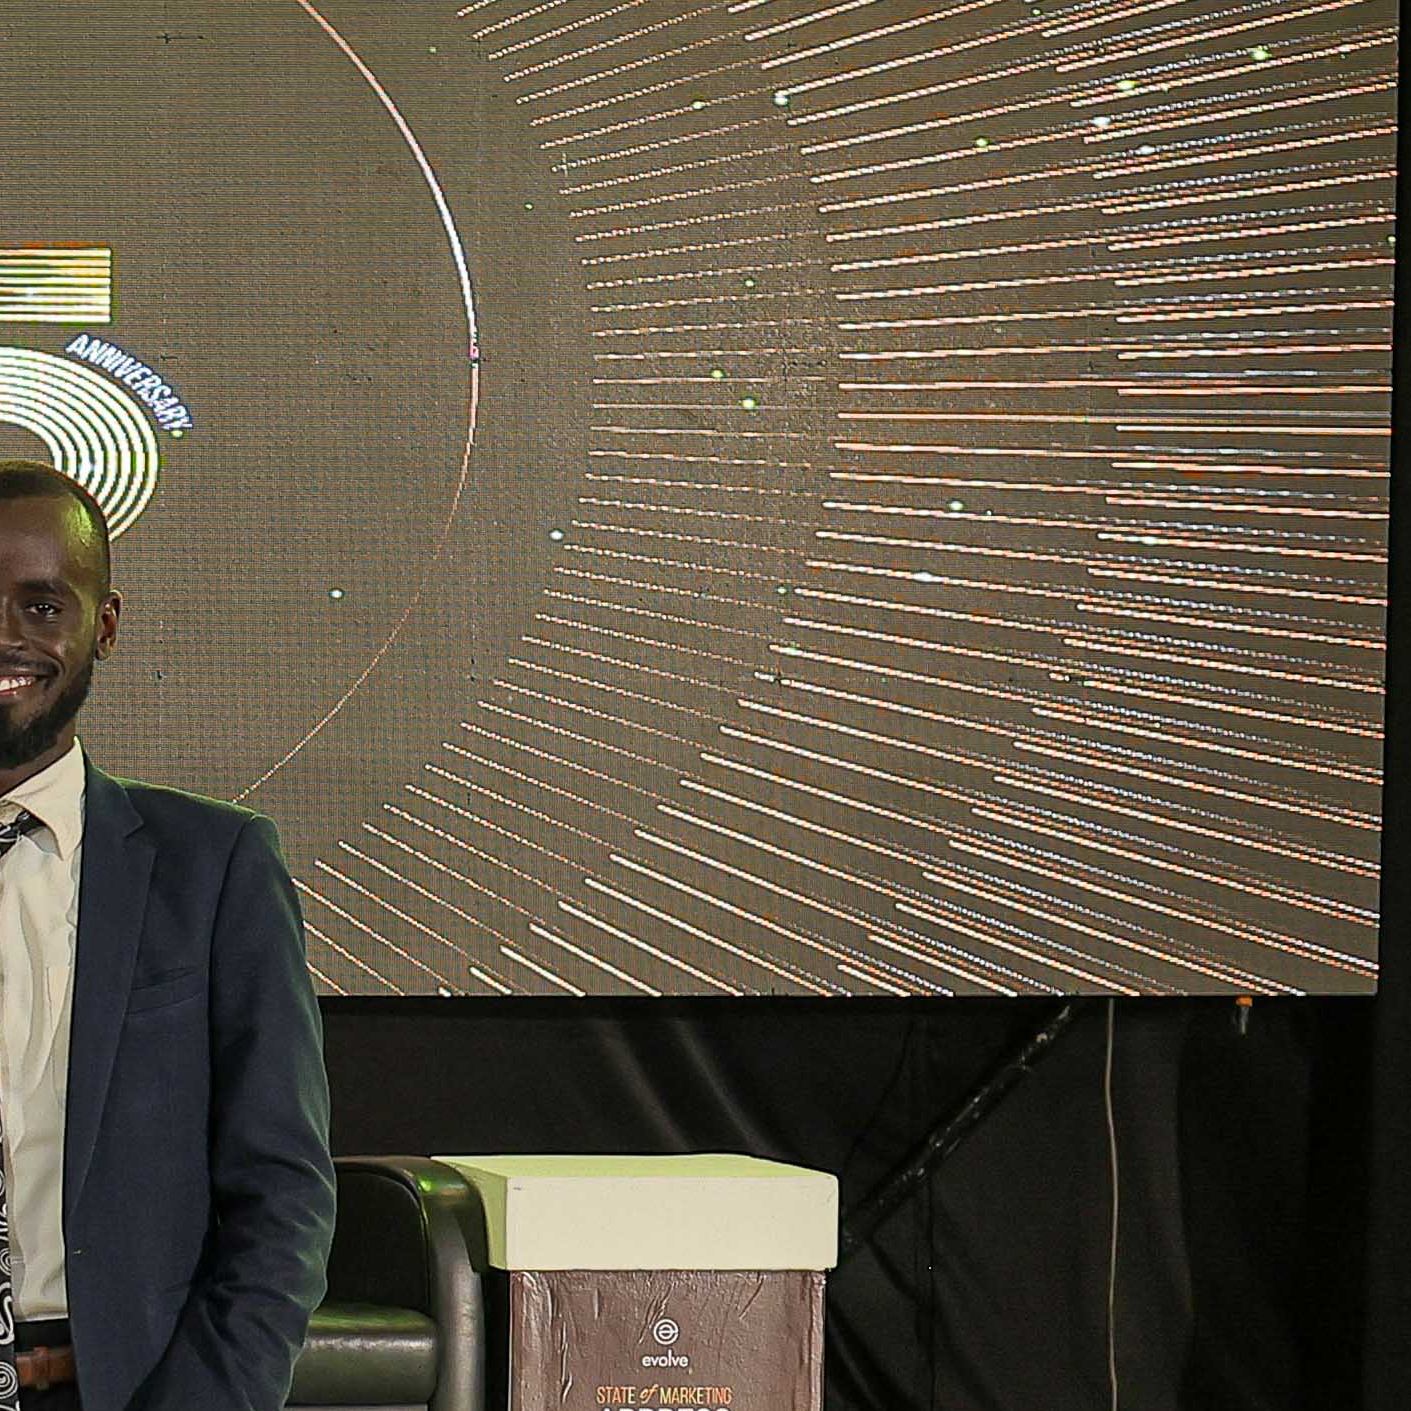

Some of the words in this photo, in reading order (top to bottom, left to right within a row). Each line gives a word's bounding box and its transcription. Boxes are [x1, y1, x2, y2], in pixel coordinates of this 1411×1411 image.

[65, 332, 193, 430] ANNIVERSARY
[641, 1349, 689, 1367] evolve
[596, 1386, 636, 1404] STATE
[639, 1383, 659, 1404] of
[659, 1386, 733, 1404] MARKETING
